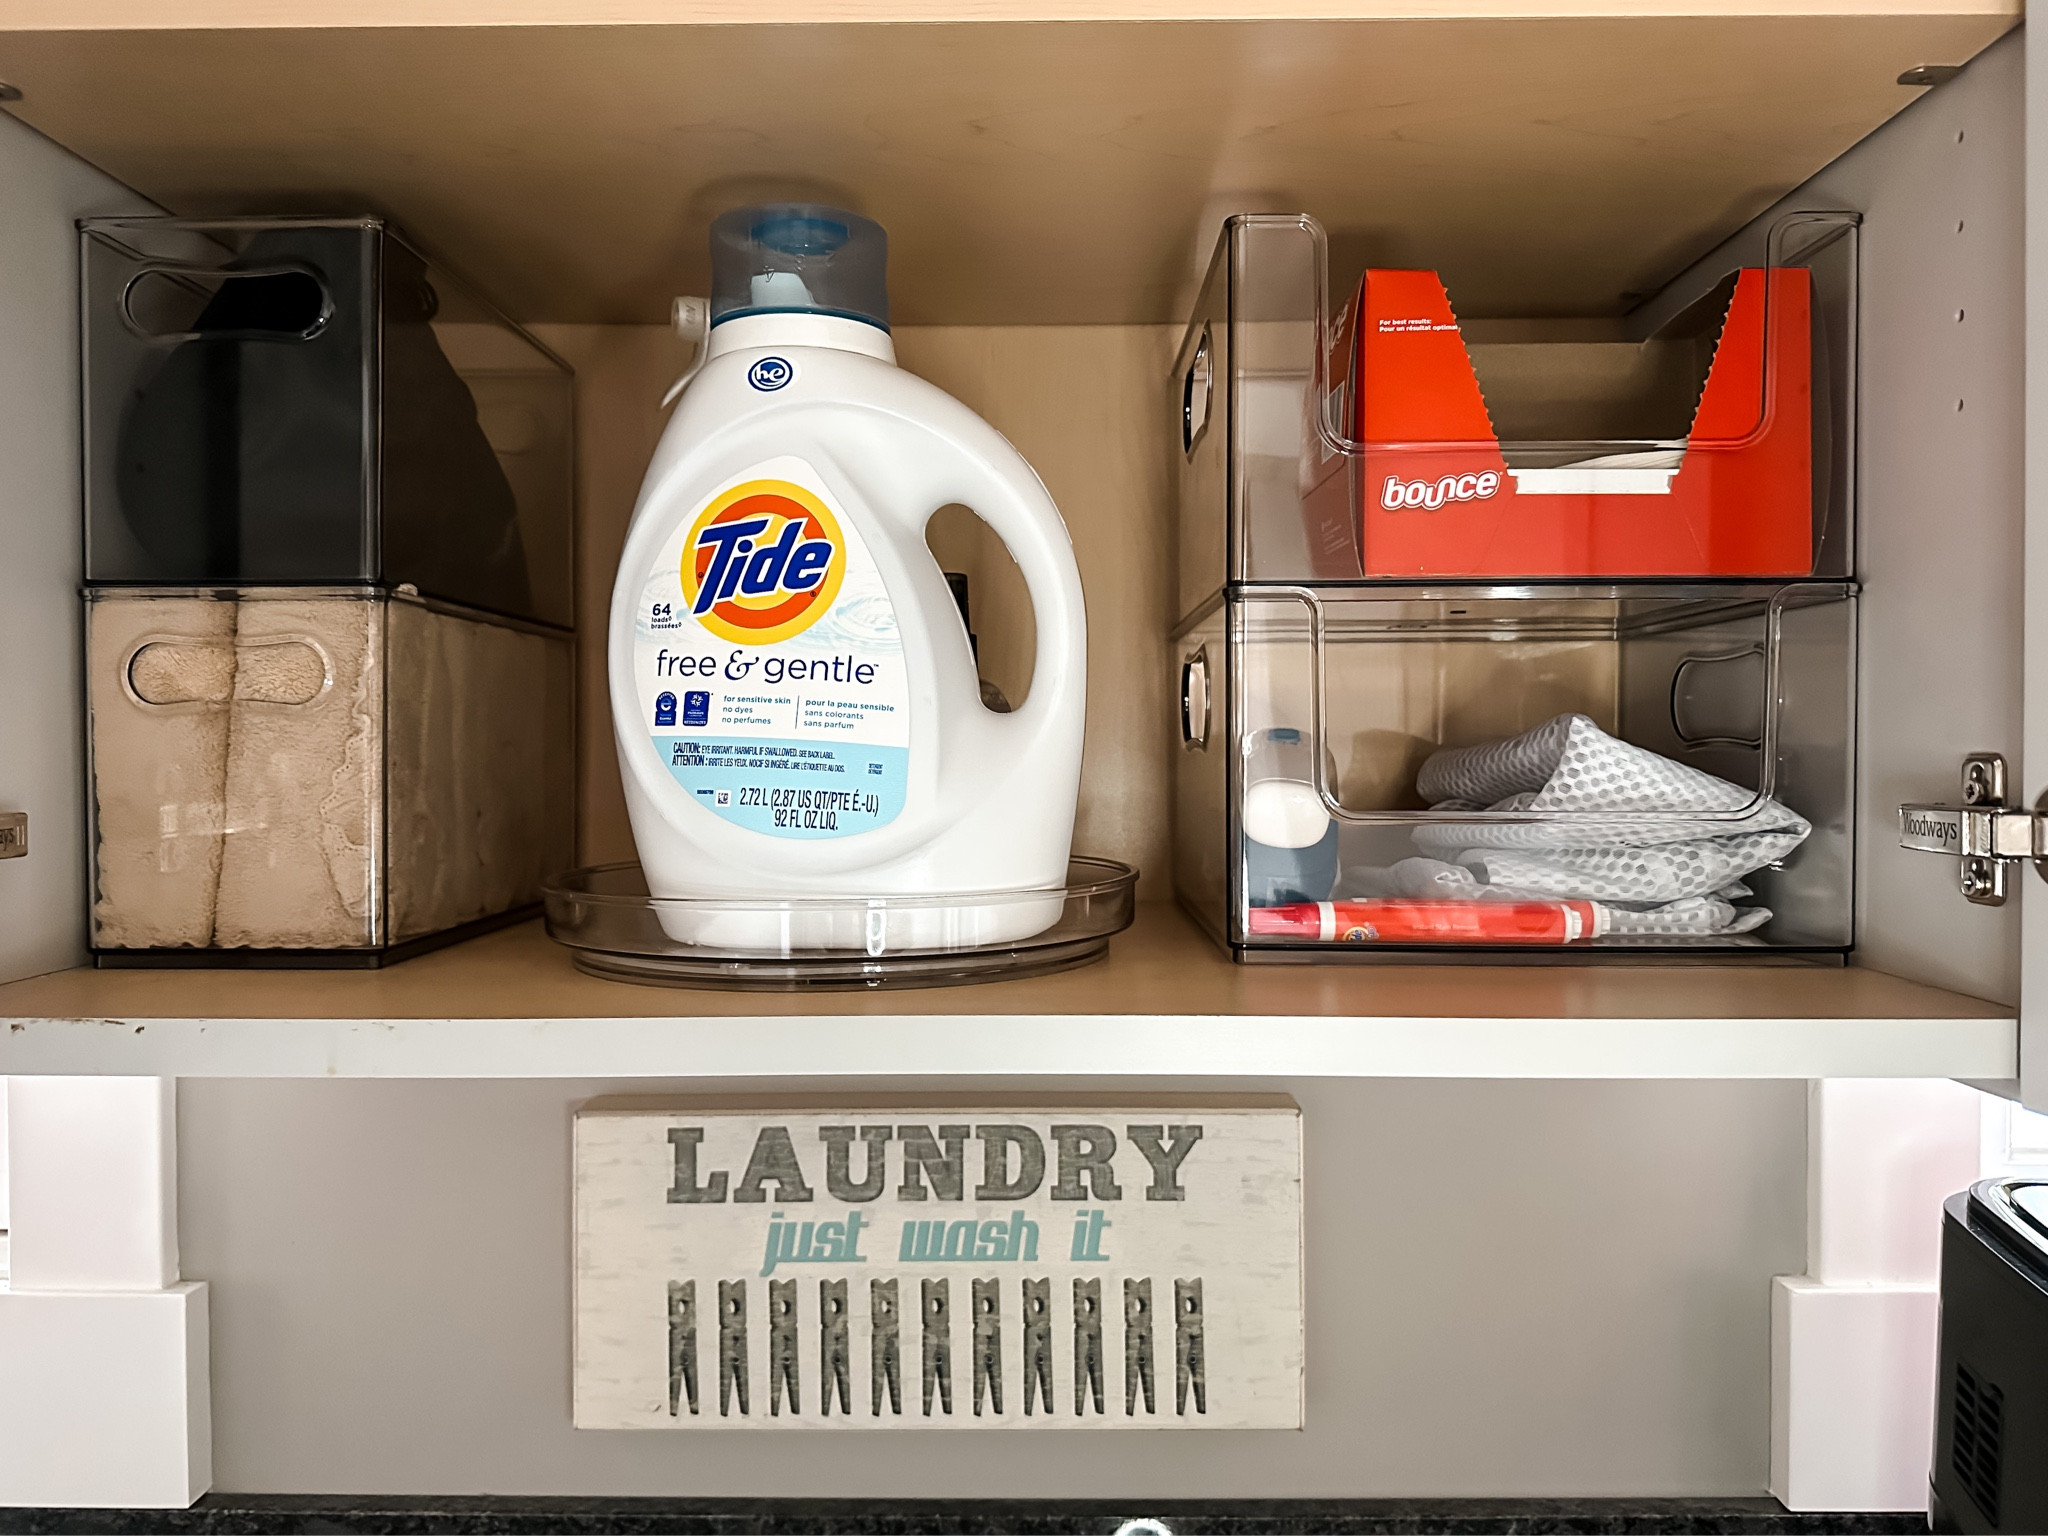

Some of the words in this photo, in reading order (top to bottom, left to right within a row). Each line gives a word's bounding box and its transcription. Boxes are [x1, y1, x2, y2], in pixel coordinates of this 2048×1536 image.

[1382, 471, 1499, 509] bounce
[692, 517, 834, 616] Tide
[652, 603, 672, 616] 64
[656, 649, 717, 677] free
[724, 649, 760, 681] &
[724, 695, 735, 703] for
[737, 696, 772, 704] sensitive
[775, 697, 791, 705] skin
[860, 703, 895, 712] sensible
[735, 705, 753, 714] dyes
[825, 711, 864, 720] colorants
[734, 716, 771, 725] perfumes
[824, 721, 854, 729] parfum
[673, 742, 700, 754] CAUTION:
[701, 745, 710, 754] EYE
[735, 746, 758, 756] HARMFUL
[758, 747, 764, 756] IF
[798, 749, 807, 758] SEE
[807, 750, 820, 759] BACK
[724, 758, 733, 767] LES
[764, 759, 770, 768] SI
[791, 761, 800, 770] LIRE
[828, 764, 835, 772] AU
[740, 787, 760, 806] 2.72
[763, 788, 768, 806] L
[771, 789, 796, 811] (2.87
[798, 789, 811, 809] US
[814, 791, 850, 812] QT/PTE
[775, 809, 787, 827] 92
[790, 810, 801, 828] FL
[804, 810, 818, 829] OZ
[820, 812, 838, 831] LIQ.
[1903, 812, 1957, 847] Woodways
[667, 1125, 1203, 1203] LAUNDRY
[759, 1210, 869, 1277] just
[899, 1210, 1039, 1261] wash
[1070, 1210, 1112, 1261] it
